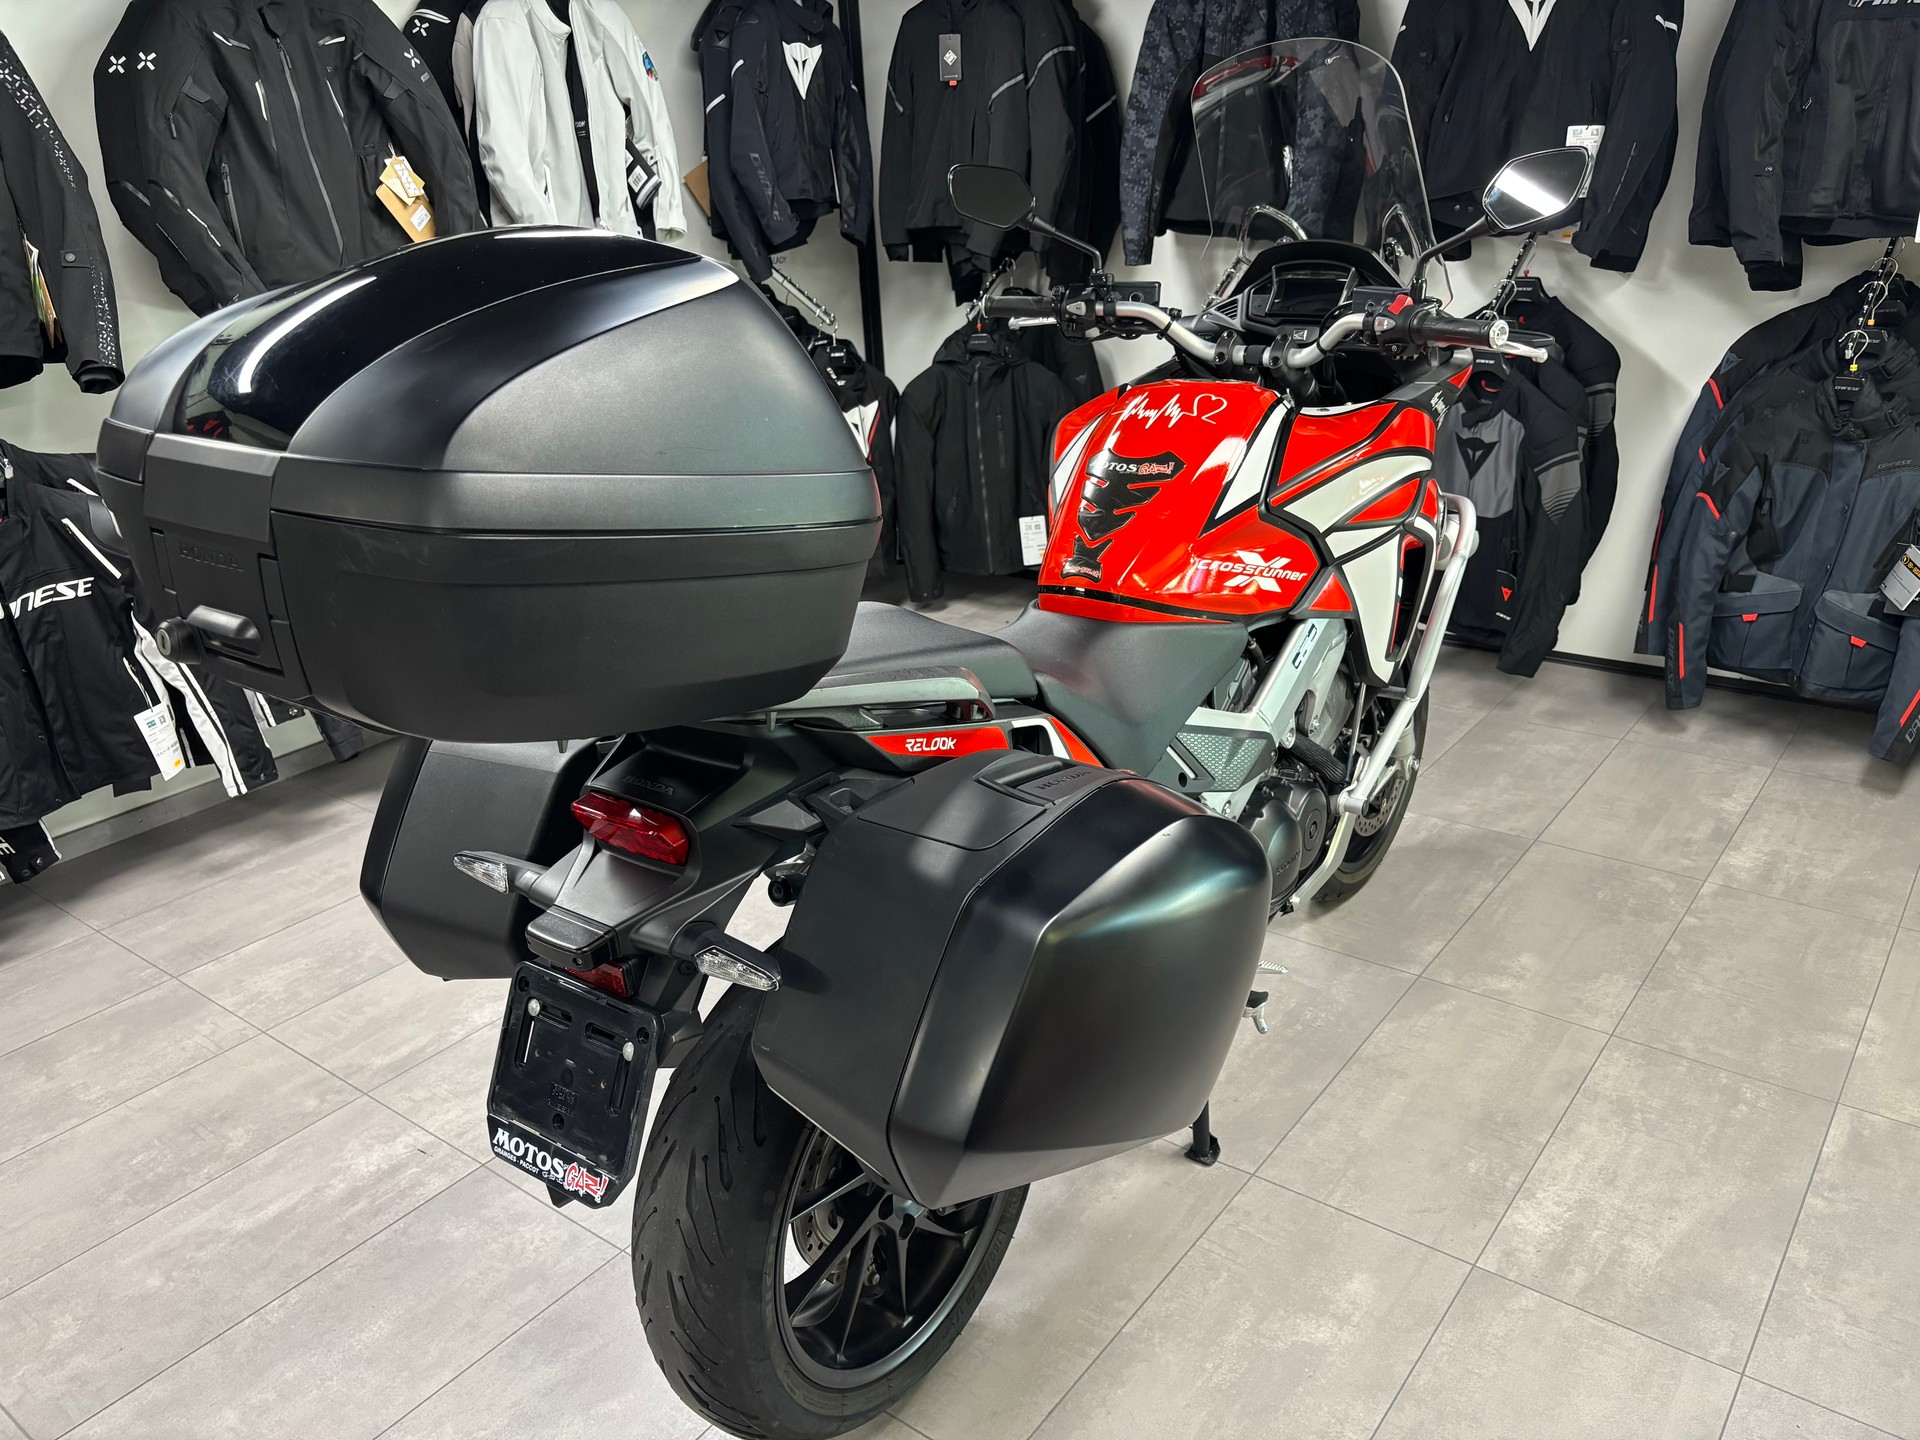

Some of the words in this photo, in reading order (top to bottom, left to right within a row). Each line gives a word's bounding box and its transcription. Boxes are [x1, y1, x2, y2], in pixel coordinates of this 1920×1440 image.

[905, 736, 957, 753] RELOOK
[1036, 771, 1092, 791] HONDA
[492, 1127, 565, 1179] MOTOS
[519, 1158, 540, 1175] PACCOT
